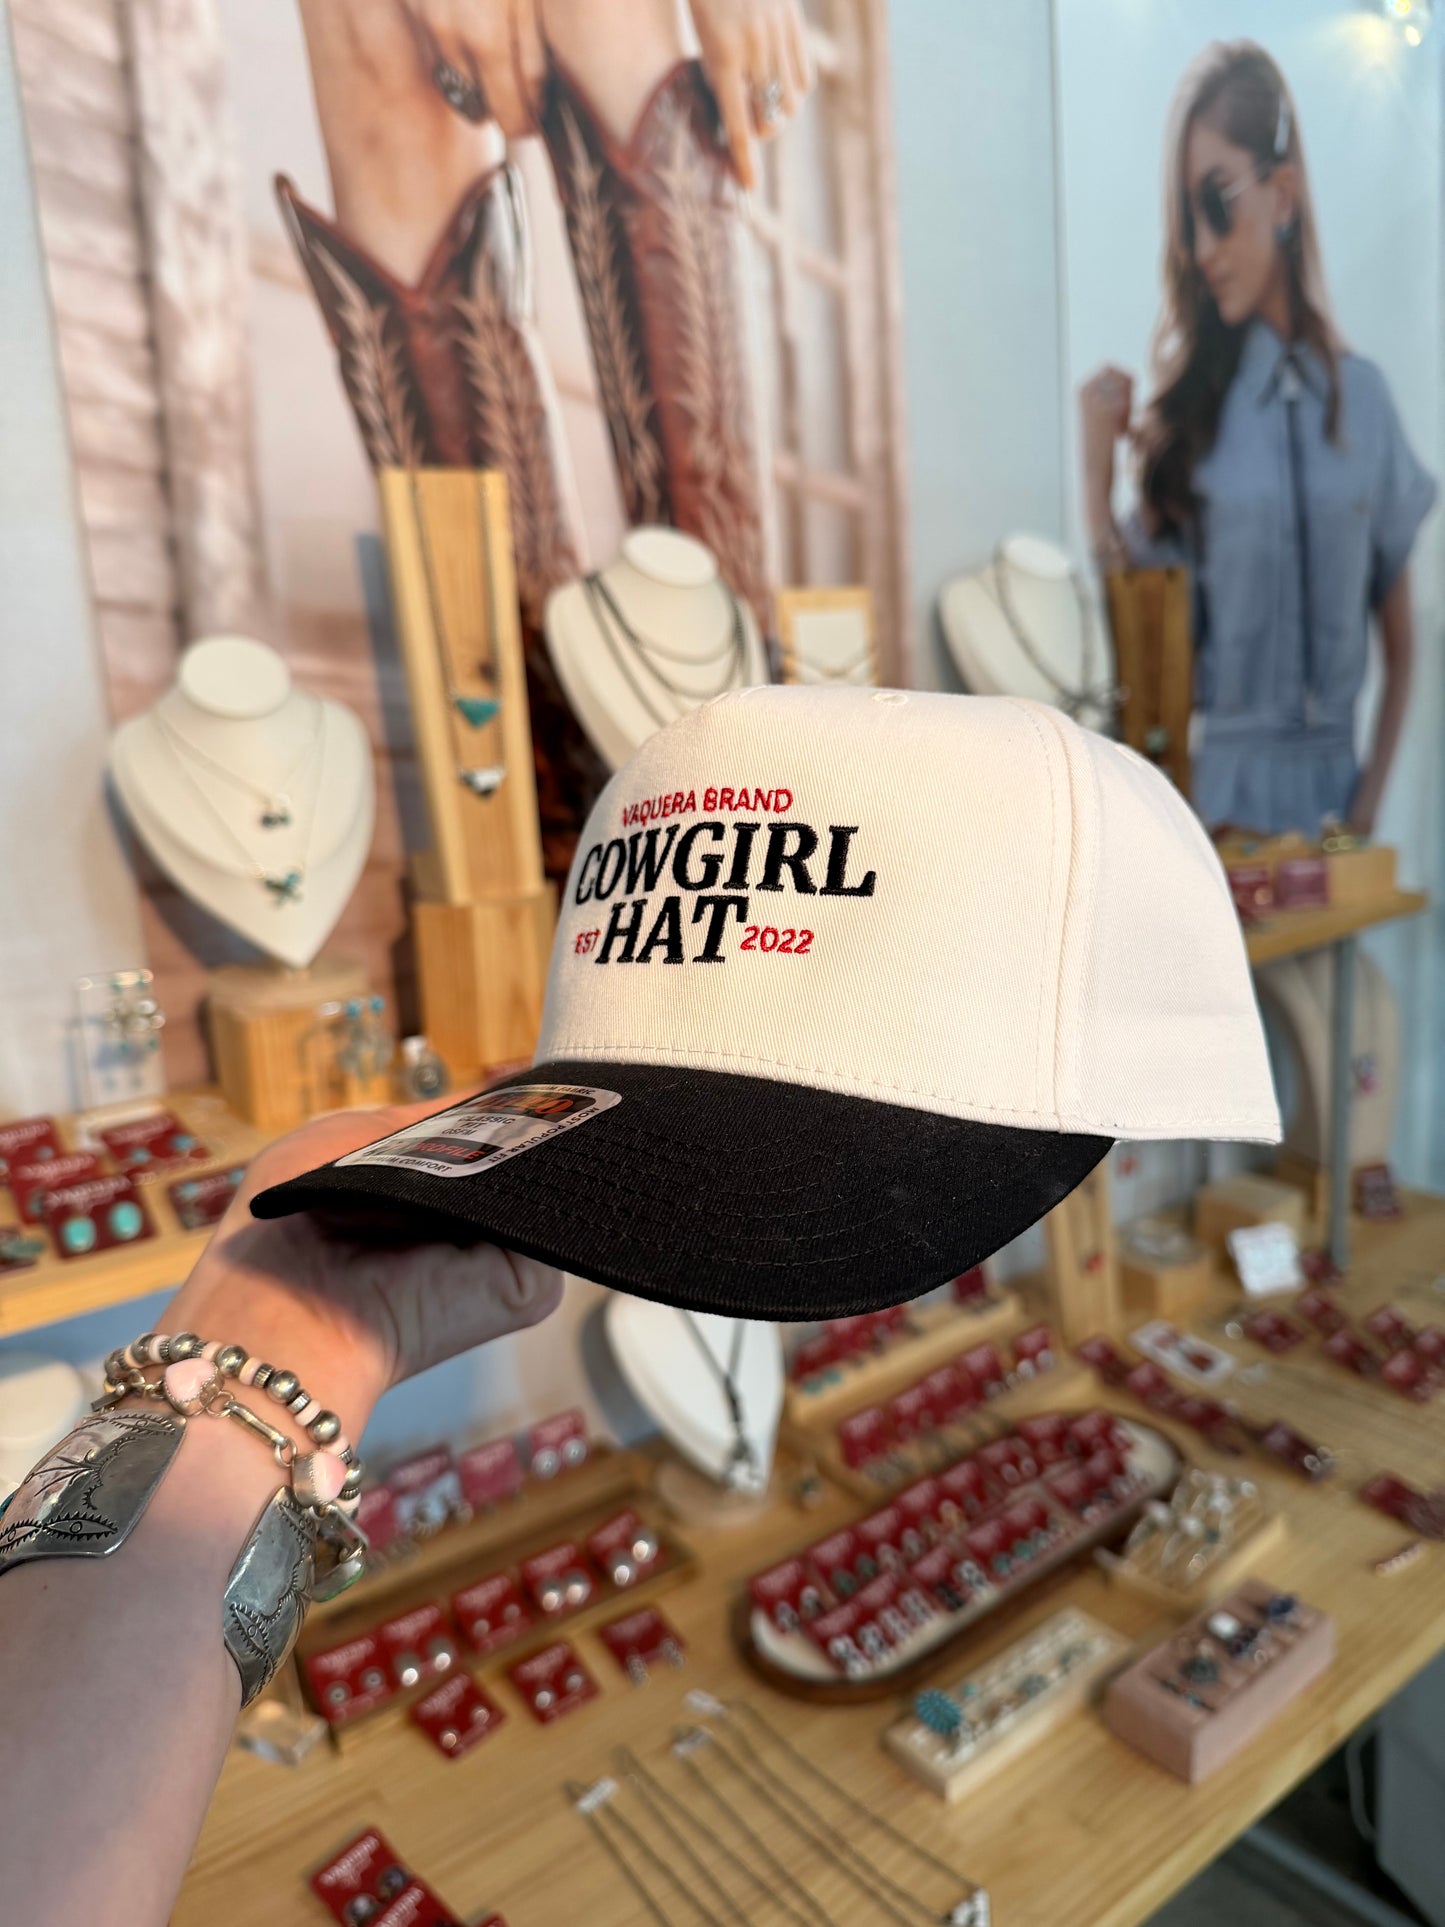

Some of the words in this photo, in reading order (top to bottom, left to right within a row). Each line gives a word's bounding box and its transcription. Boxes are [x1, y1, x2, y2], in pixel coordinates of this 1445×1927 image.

[623, 789, 696, 827] VAQUERA
[703, 787, 794, 814] BRAND
[575, 821, 877, 905] COWGIRL
[574, 929, 601, 954] EST
[594, 894, 750, 965] HAT
[740, 925, 815, 954] 2022
[568, 1106, 600, 1126] MOST
[510, 1124, 566, 1153] POPULAR
